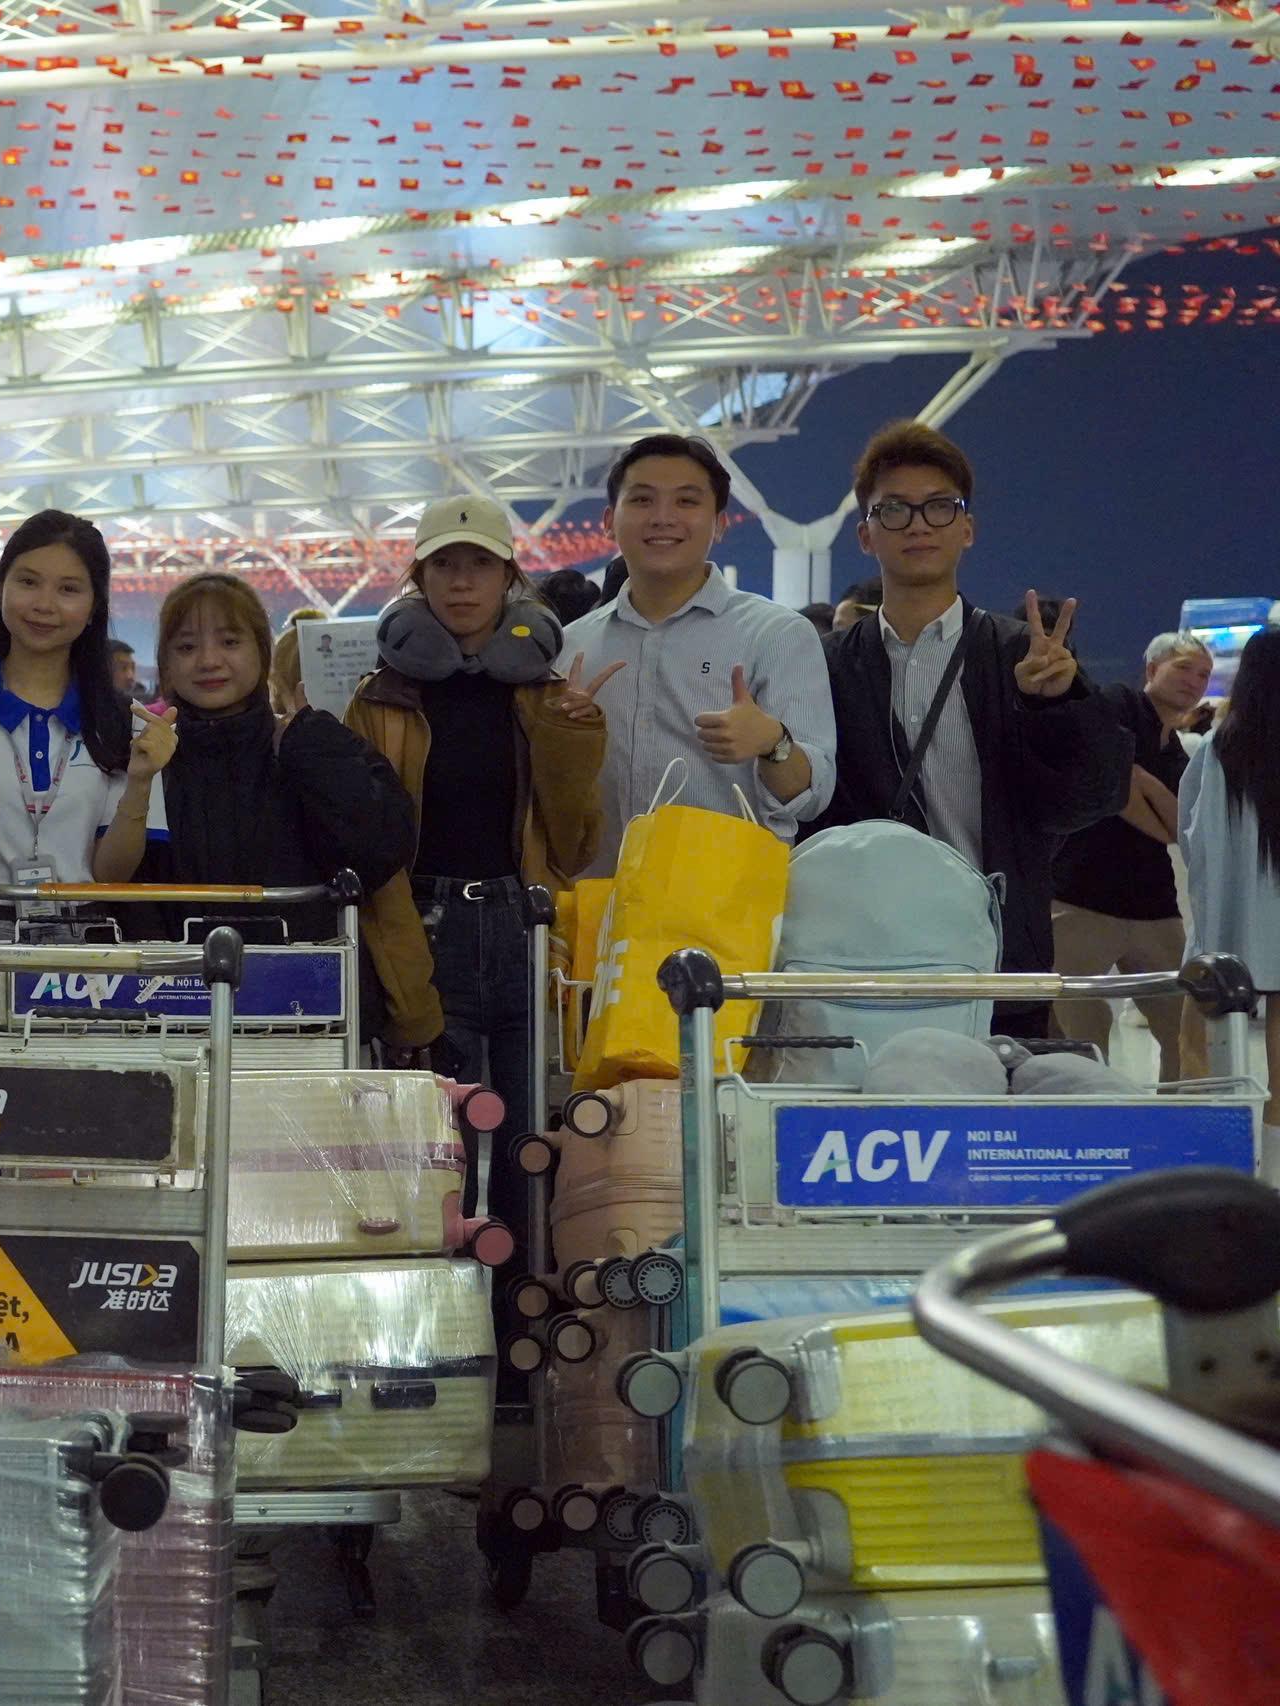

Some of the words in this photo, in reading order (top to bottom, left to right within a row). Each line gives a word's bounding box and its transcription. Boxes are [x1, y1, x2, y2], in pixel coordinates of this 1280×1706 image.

[700, 661, 711, 674] S
[967, 1130, 991, 1142] NOI
[994, 1130, 1017, 1142] BAI
[801, 1129, 951, 1183] ACV
[967, 1148, 1072, 1160] INTERNATIONAL
[1074, 1148, 1131, 1160] AIRPORT
[99, 1289, 172, 1312] 准时达
